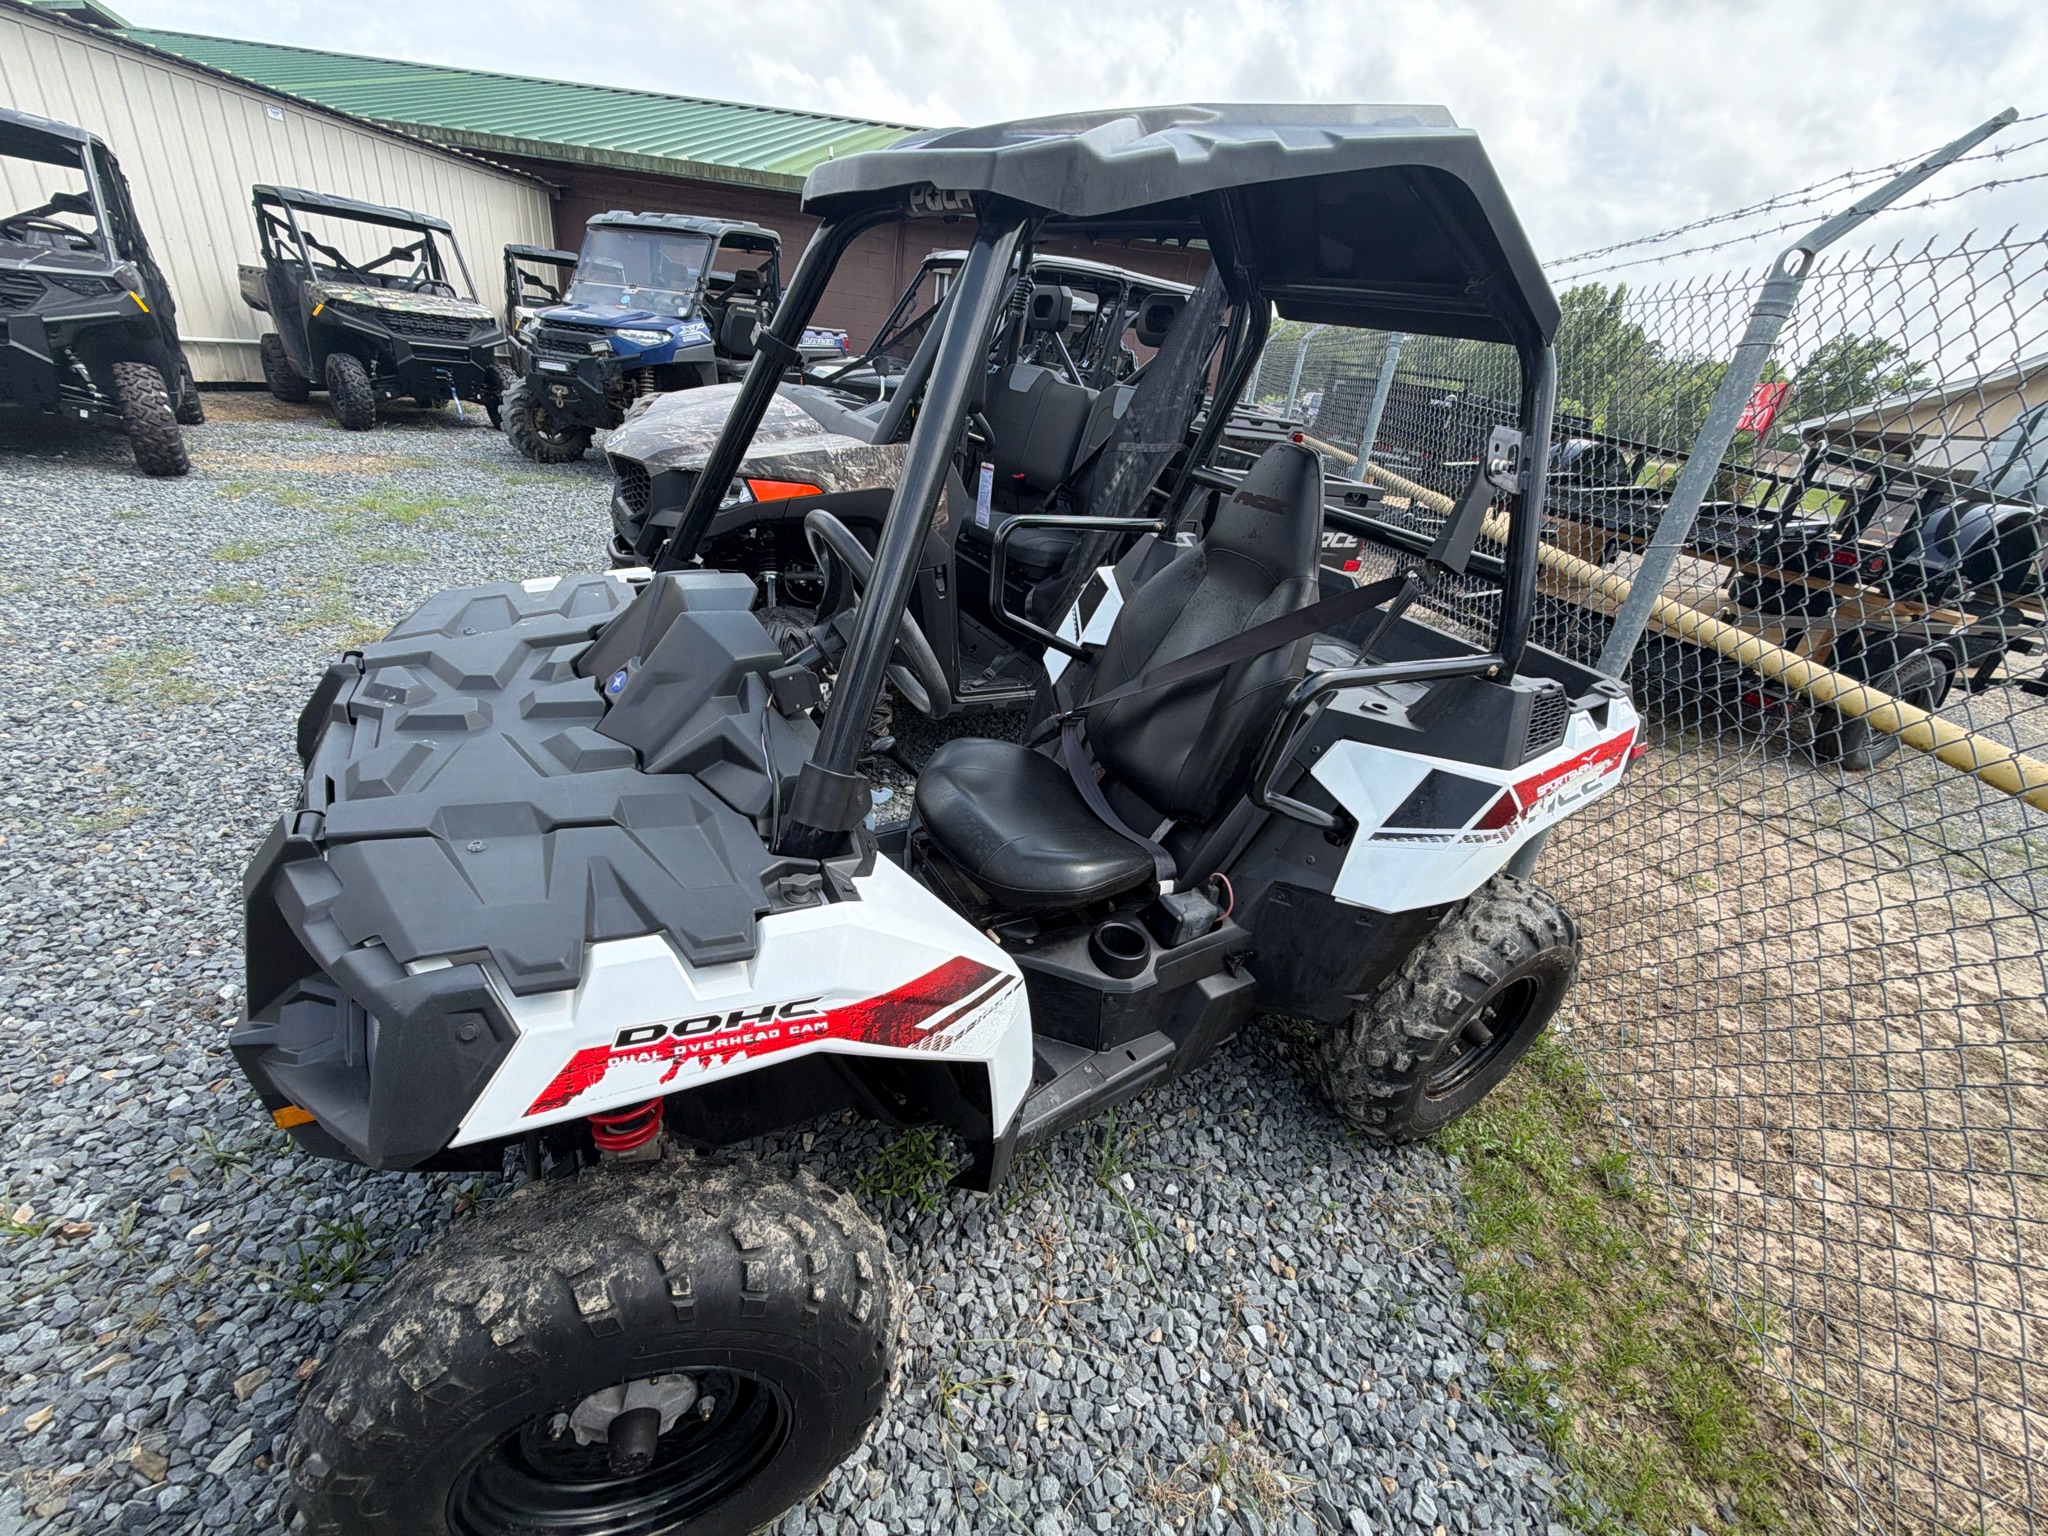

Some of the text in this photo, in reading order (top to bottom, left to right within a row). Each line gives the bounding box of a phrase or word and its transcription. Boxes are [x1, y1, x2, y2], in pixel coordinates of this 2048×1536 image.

[400, 320, 459, 332] POLARIS
[1536, 761, 1594, 798] SPORTSMAN
[613, 996, 825, 1049] DOHC
[607, 1020, 829, 1068] DUAL OVERHEAD CAM
